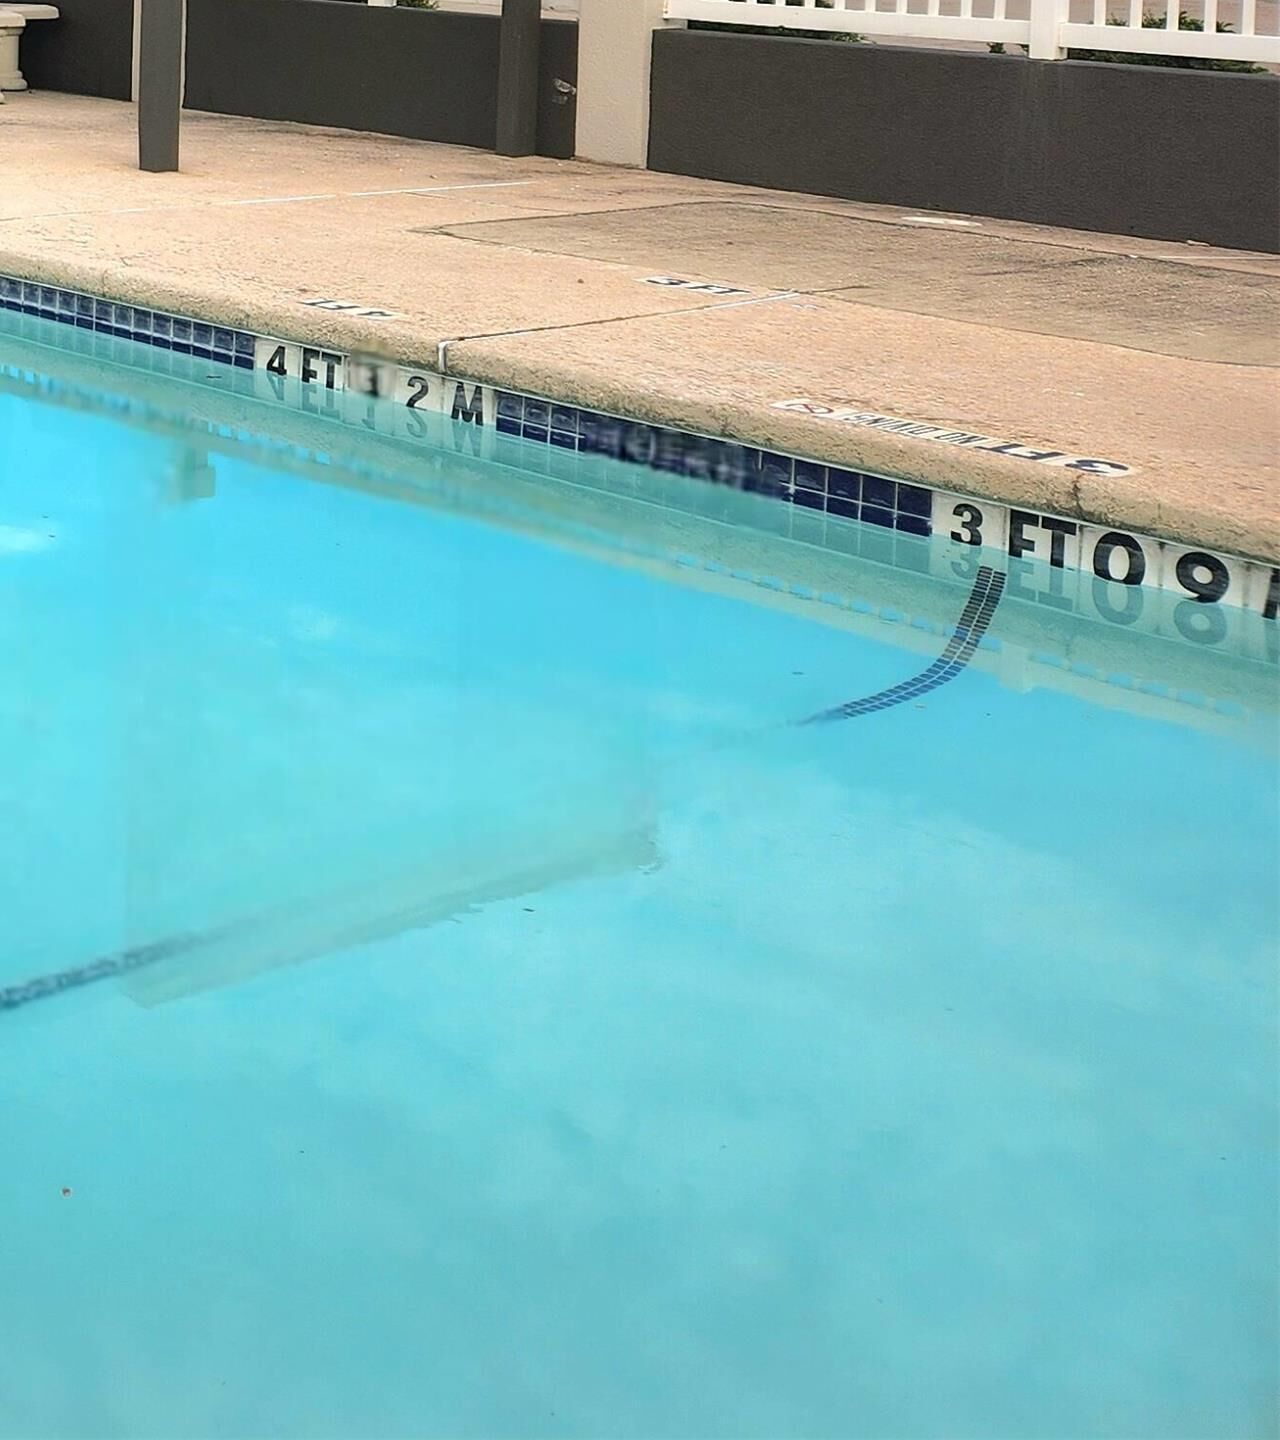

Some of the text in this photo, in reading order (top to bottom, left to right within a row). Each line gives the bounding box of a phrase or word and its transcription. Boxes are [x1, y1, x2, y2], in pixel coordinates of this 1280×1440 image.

[267, 345, 287, 376] 4
[302, 348, 342, 390] FT
[406, 376, 429, 410] 2
[451, 381, 483, 427] M
[1064, 459, 1130, 474] 3
[950, 503, 983, 546] 3
[1008, 510, 1077, 568] FT
[1176, 551, 1230, 604] 9
